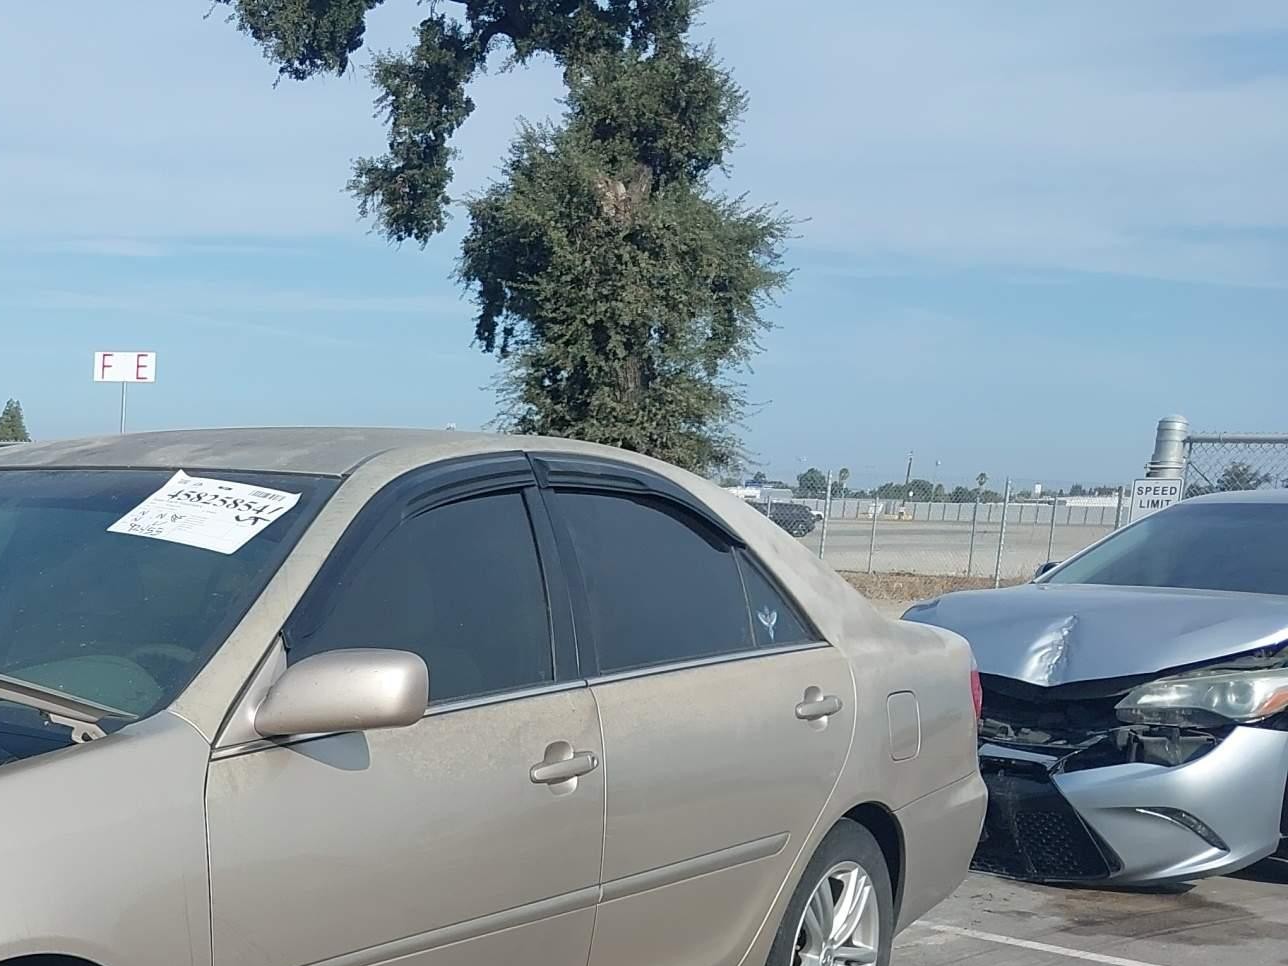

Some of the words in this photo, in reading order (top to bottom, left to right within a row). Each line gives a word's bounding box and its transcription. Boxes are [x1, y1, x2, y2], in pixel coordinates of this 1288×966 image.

[101, 353, 114, 379] F
[136, 353, 148, 379] E
[1136, 486, 1178, 496] SPEED
[1139, 499, 1172, 509] LIMIT
